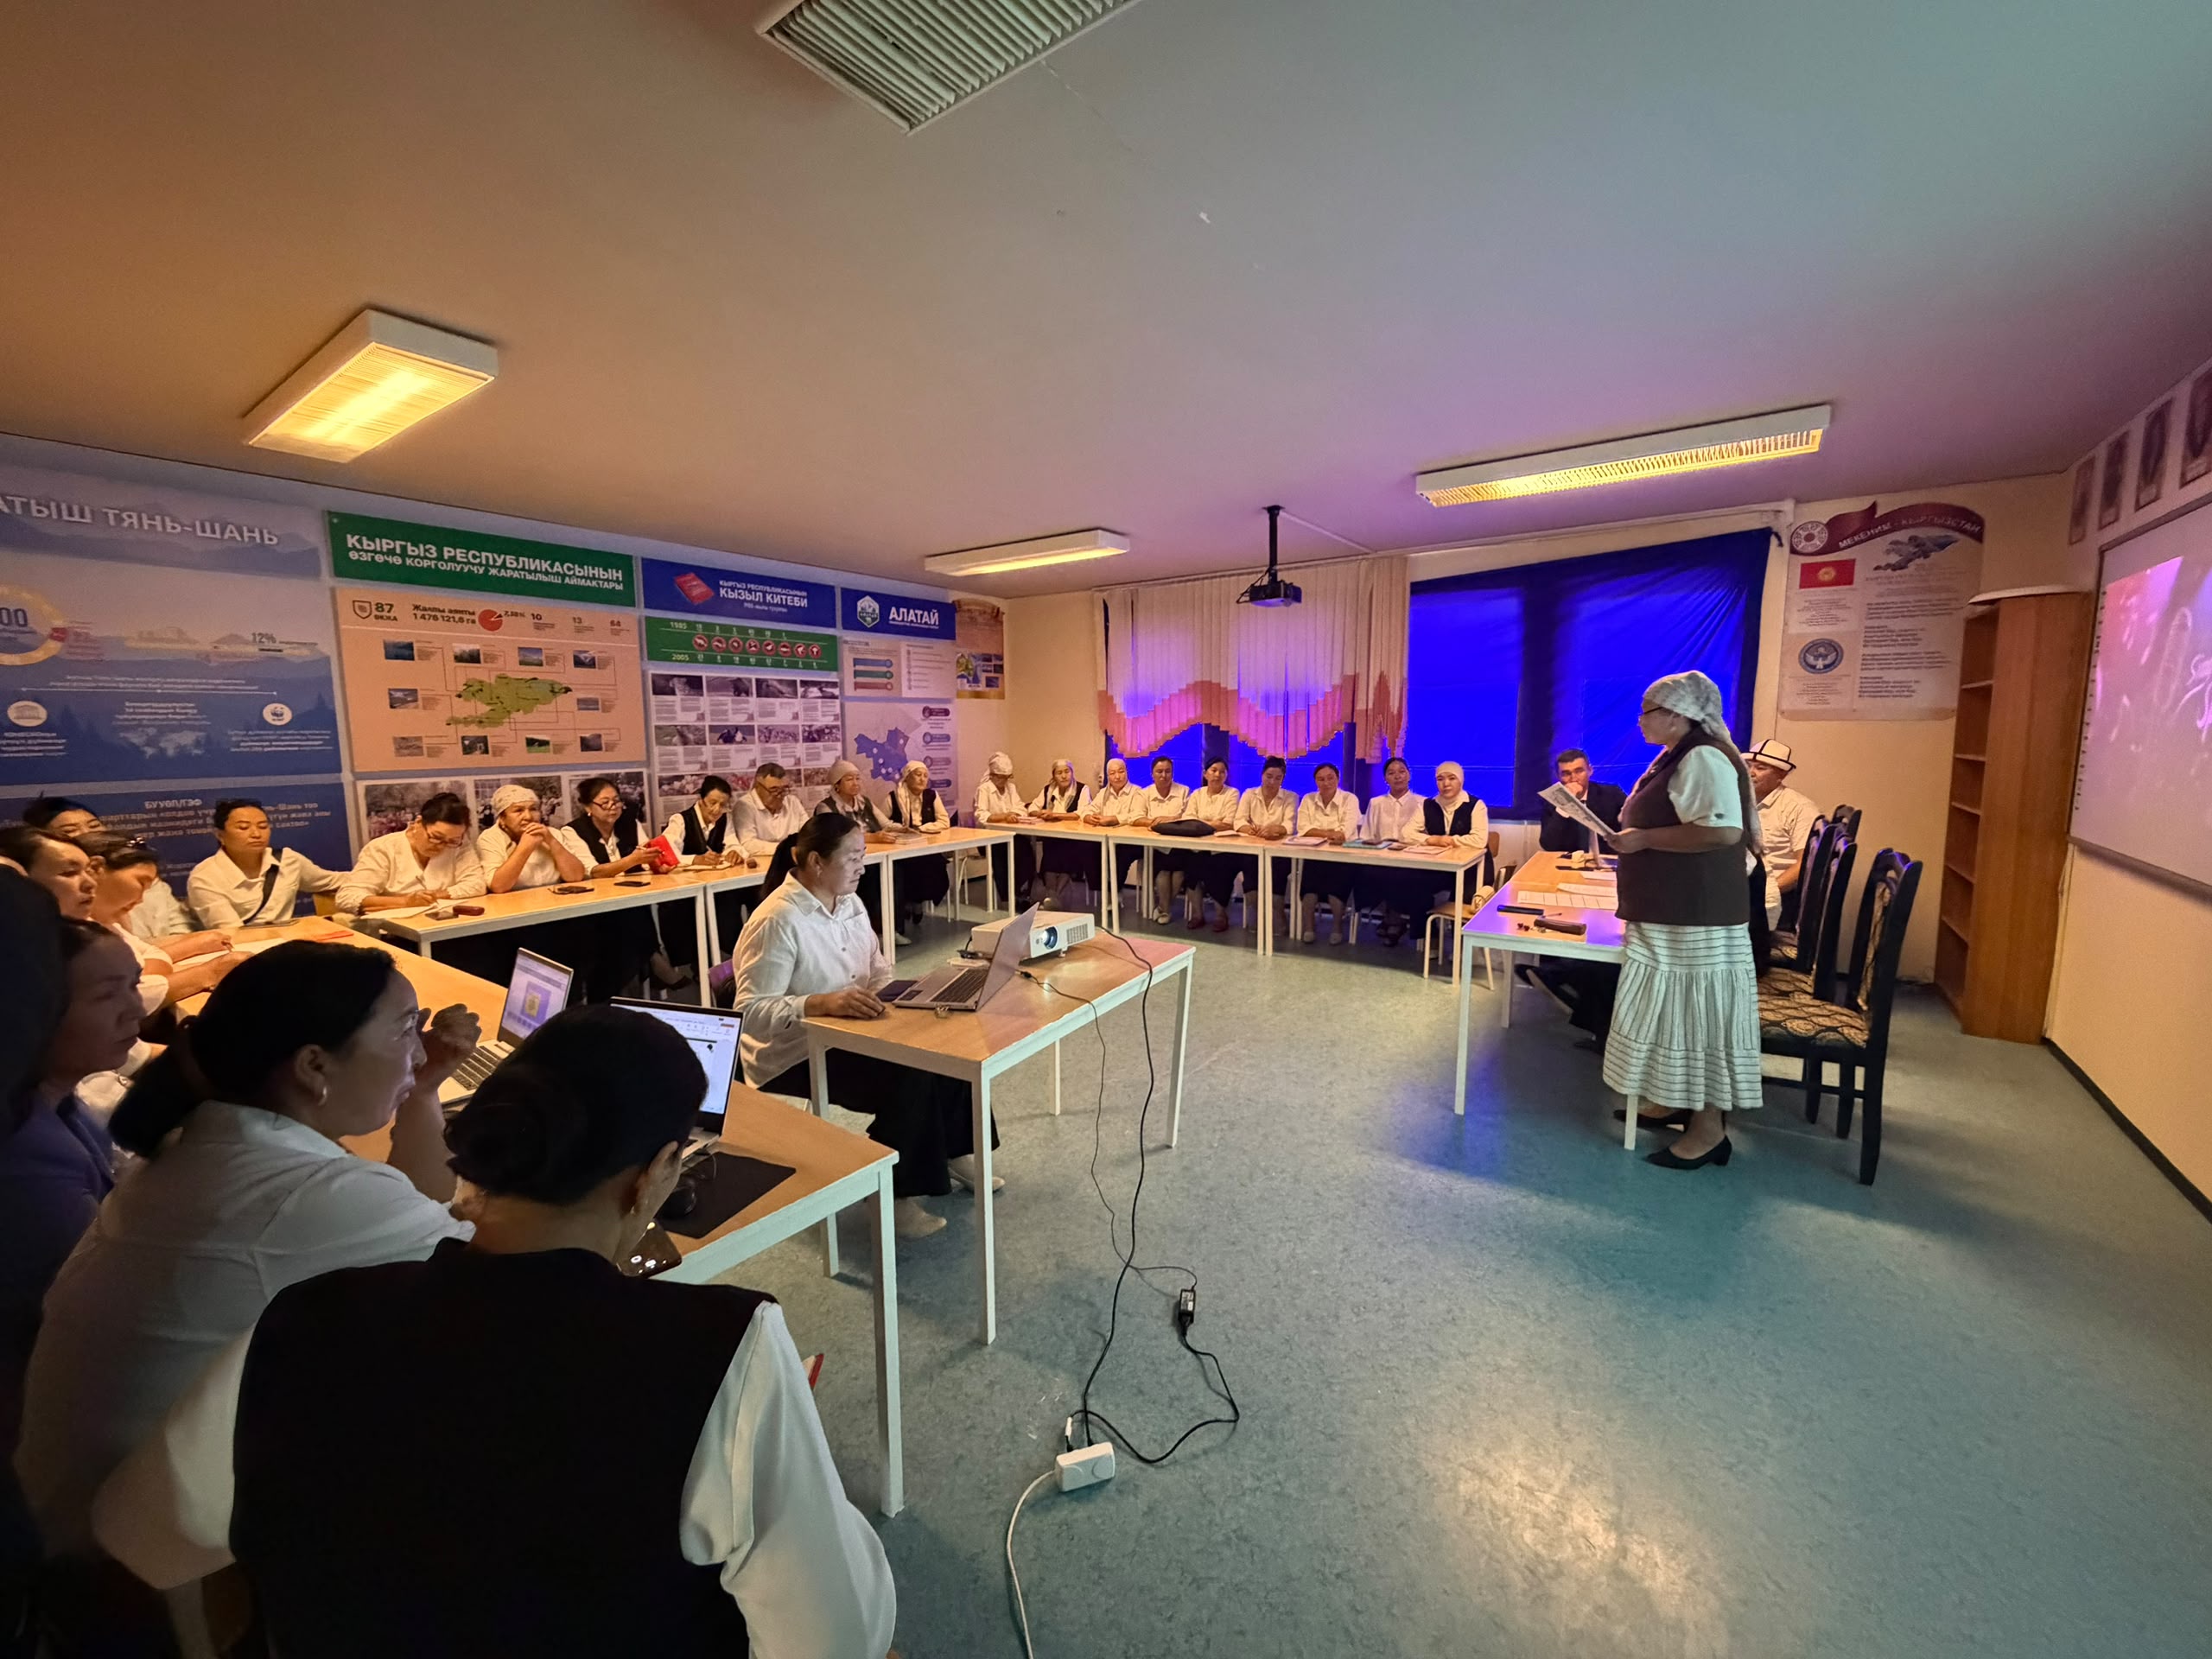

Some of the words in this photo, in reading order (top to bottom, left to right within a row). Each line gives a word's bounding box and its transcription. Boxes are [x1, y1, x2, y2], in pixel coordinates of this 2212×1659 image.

[102, 508, 278, 545] ТЯНЬ-ШАНЬ
[346, 534, 438, 558] КЫРГЫЗ
[442, 546, 623, 581] РЕСПУБЛИКАСЫНЫН
[348, 550, 403, 565] ӨЗГӨЧӨ
[405, 556, 486, 575] КОРГОЛУУЧУ
[488, 566, 562, 584] ЖАРАТЫЛЫШ
[563, 576, 624, 591] АЙМАКТАРЫ
[374, 602, 394, 613] 87
[719, 588, 763, 603] КЫЗЫЛ
[766, 593, 808, 608] КИТЕБИ
[888, 606, 939, 626] АЛАТАЙ
[251, 632, 277, 645] 12%
